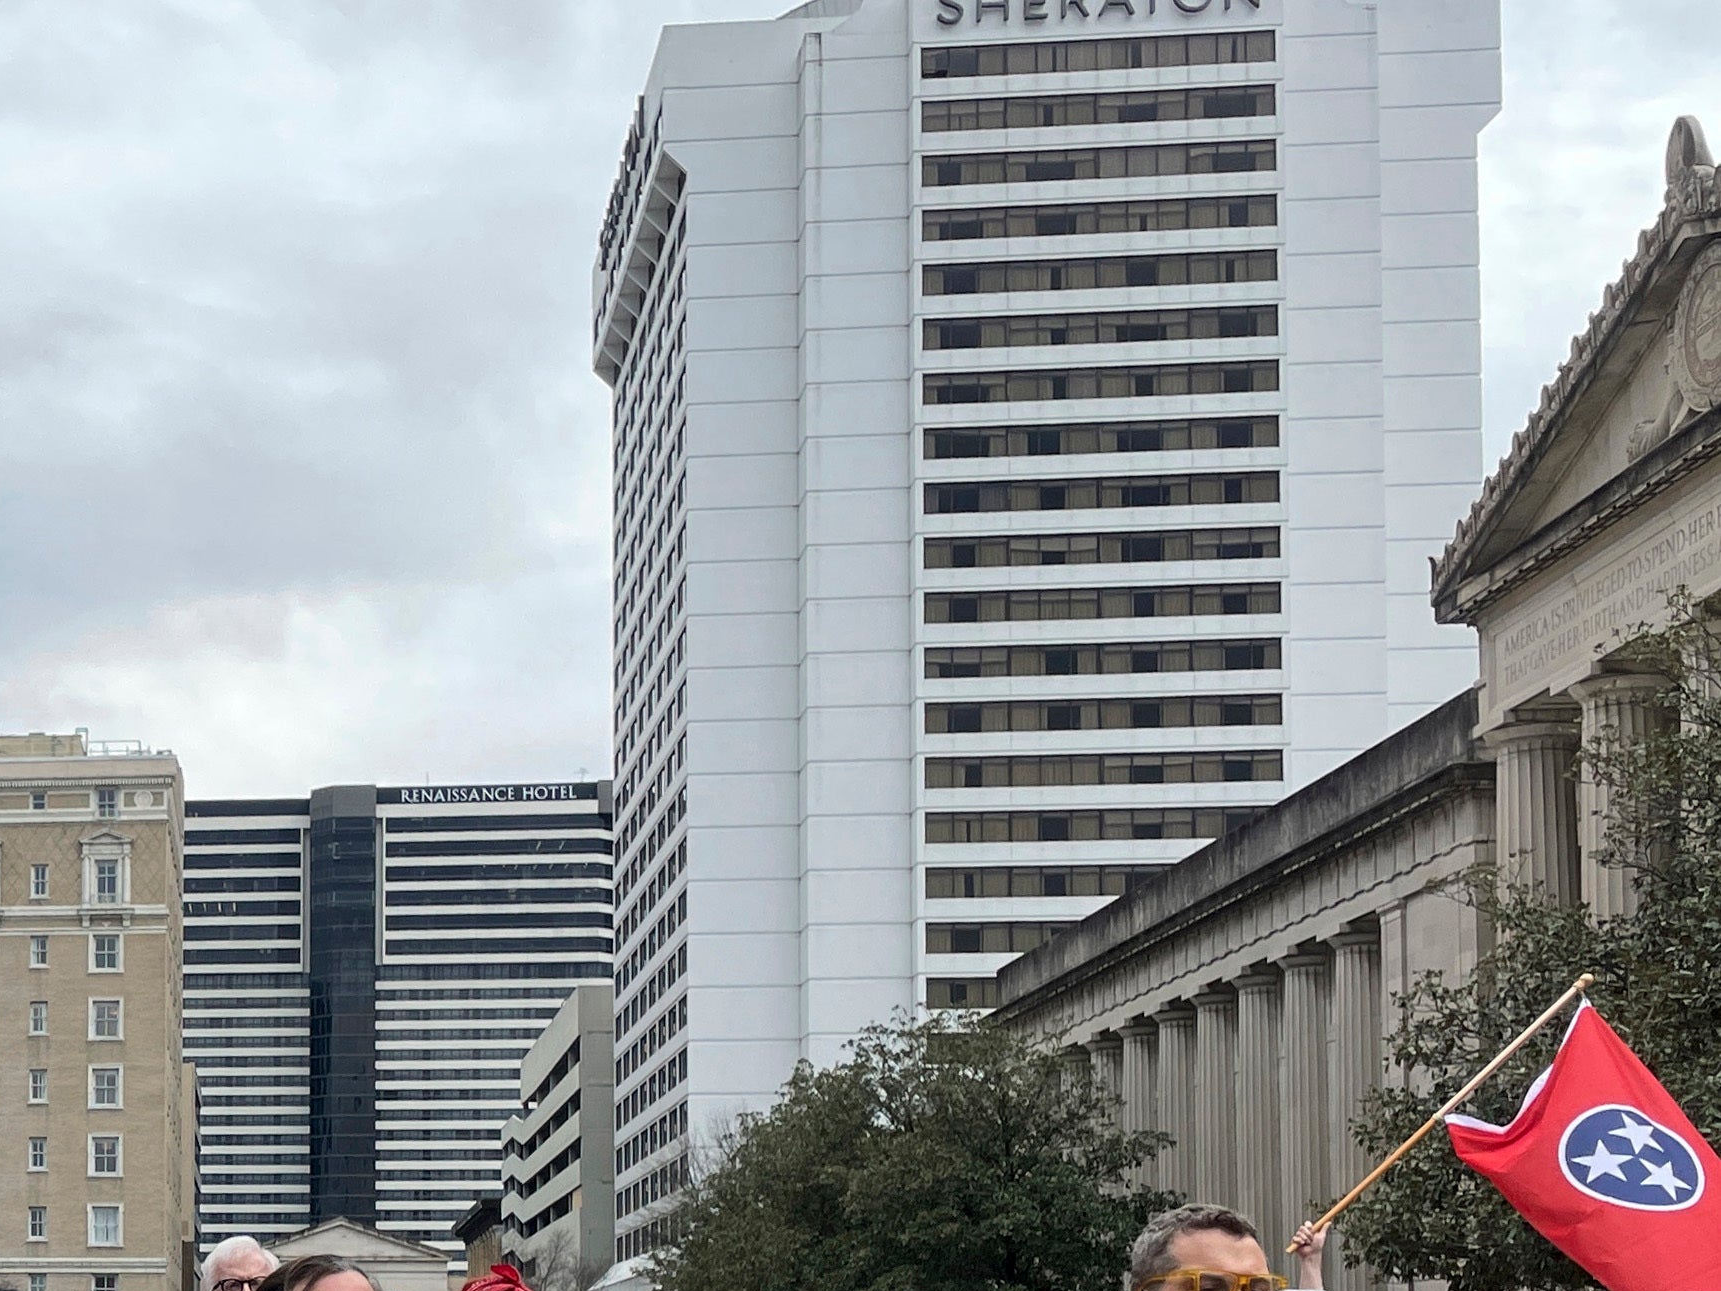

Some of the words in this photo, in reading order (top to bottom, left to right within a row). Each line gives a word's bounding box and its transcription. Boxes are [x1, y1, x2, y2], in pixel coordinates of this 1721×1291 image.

[1503, 615, 1549, 661] AMERICA
[401, 786, 515, 803] RENAISSANCE
[522, 785, 578, 800] HOTEL
